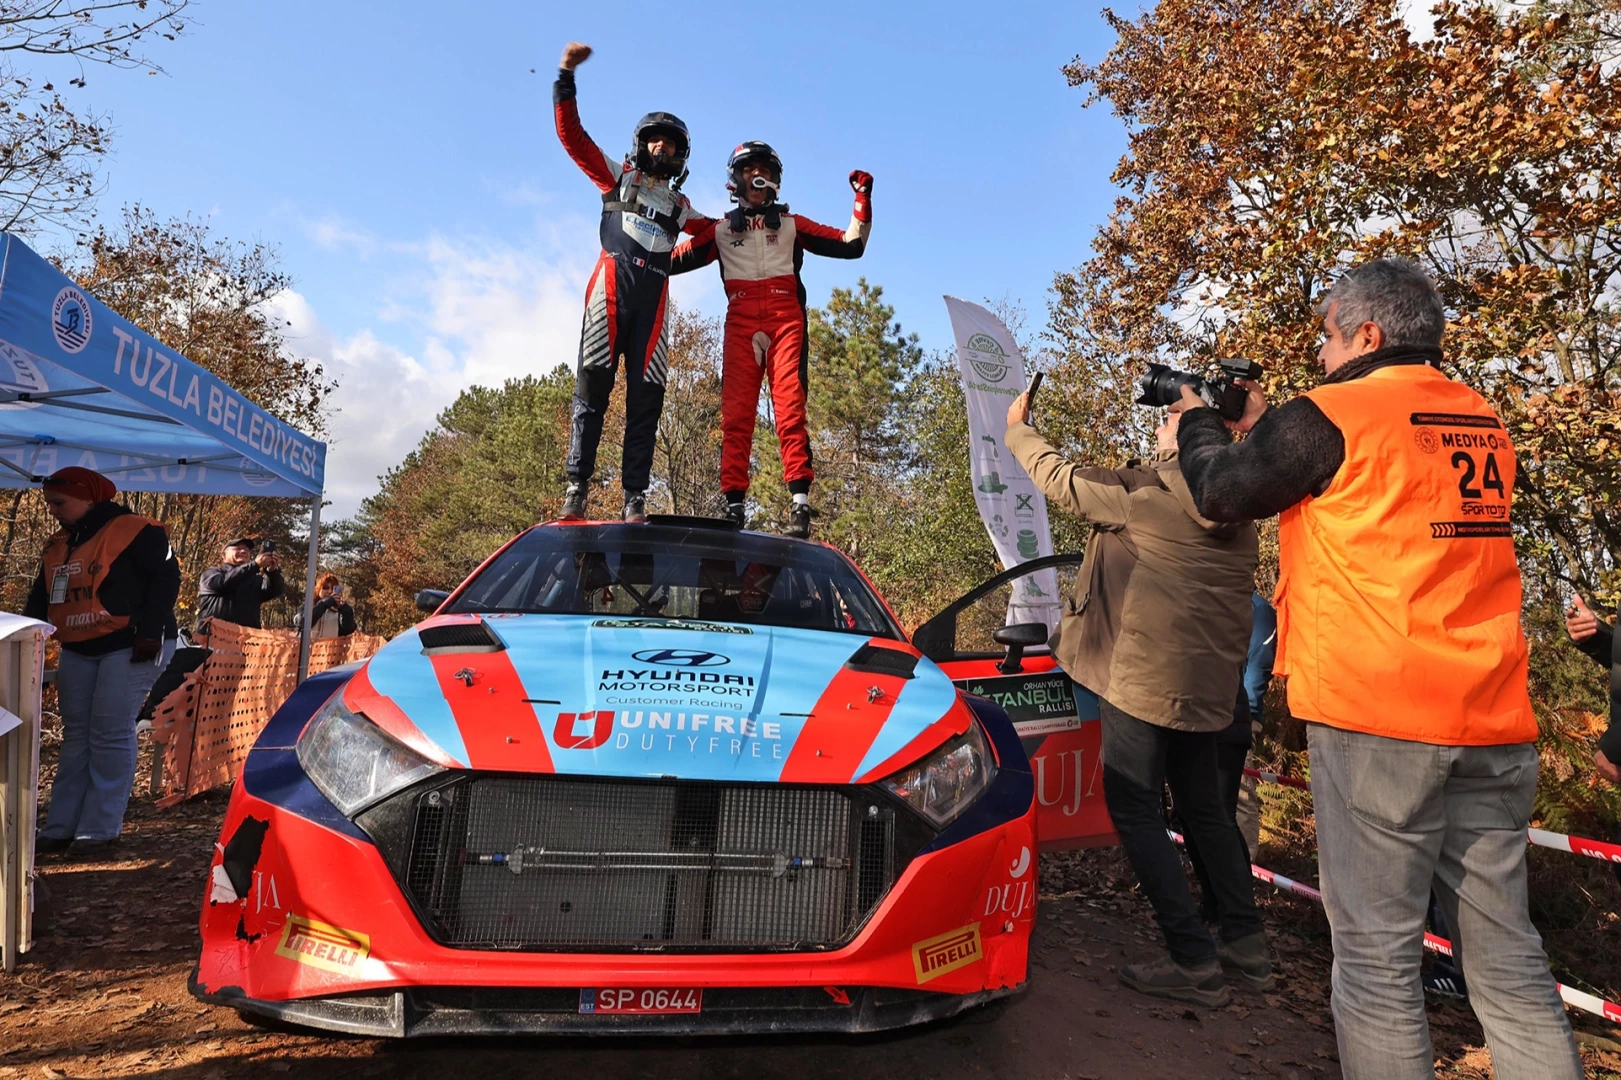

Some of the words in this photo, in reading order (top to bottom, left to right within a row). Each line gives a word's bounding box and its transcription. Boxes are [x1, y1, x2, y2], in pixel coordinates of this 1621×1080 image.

[54, 291, 69, 317] TUZLA
[112, 325, 201, 416] TUZLA
[207, 385, 317, 479] BELEDİYESİ
[1441, 433, 1487, 448] MEDYA
[1451, 451, 1505, 499] 24
[598, 682, 754, 697] MOTORSPORT
[601, 669, 755, 687] HYUNDAI
[1023, 681, 1047, 690] ORHAN
[1047, 679, 1064, 688] YÜCE
[605, 696, 685, 706] Customer
[689, 698, 743, 711] Racing
[620, 711, 782, 740] UNIFREE
[284, 922, 362, 968] PIRELLI
[919, 930, 977, 974] PIRELLI
[599, 989, 635, 1010] SP
[640, 989, 697, 1010] 0644
